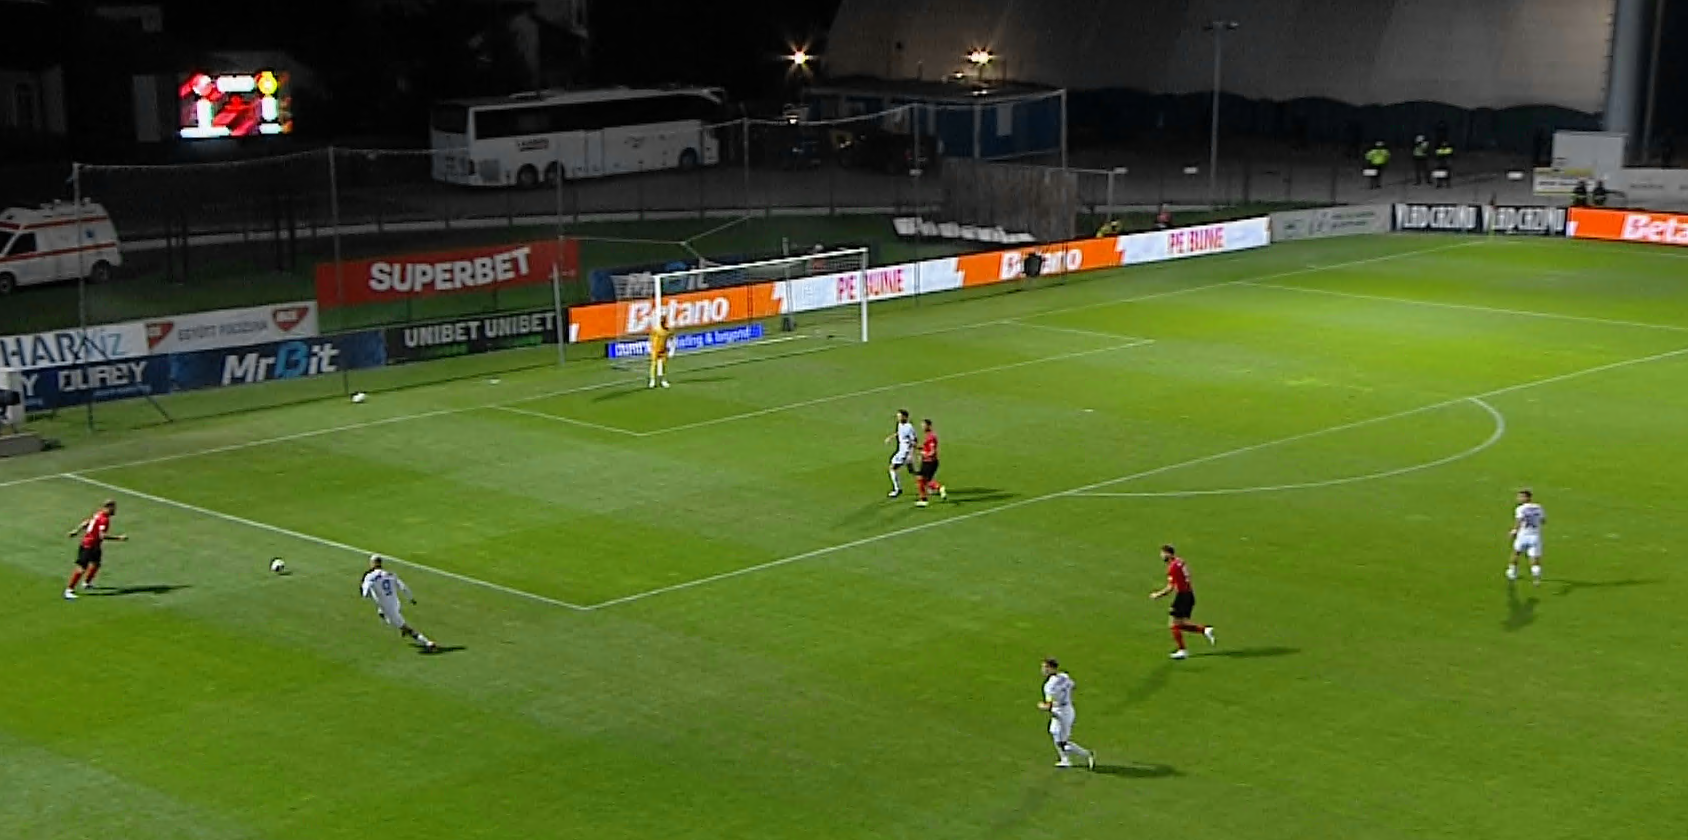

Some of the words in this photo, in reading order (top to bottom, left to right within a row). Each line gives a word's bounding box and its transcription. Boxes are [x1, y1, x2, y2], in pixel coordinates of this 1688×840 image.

[369, 246, 531, 293] SUPERBET
[403, 320, 481, 348] UNIBET
[484, 311, 556, 339] UNIBET
[220, 340, 340, 387] MrBit
[381, 578, 393, 597] 9
